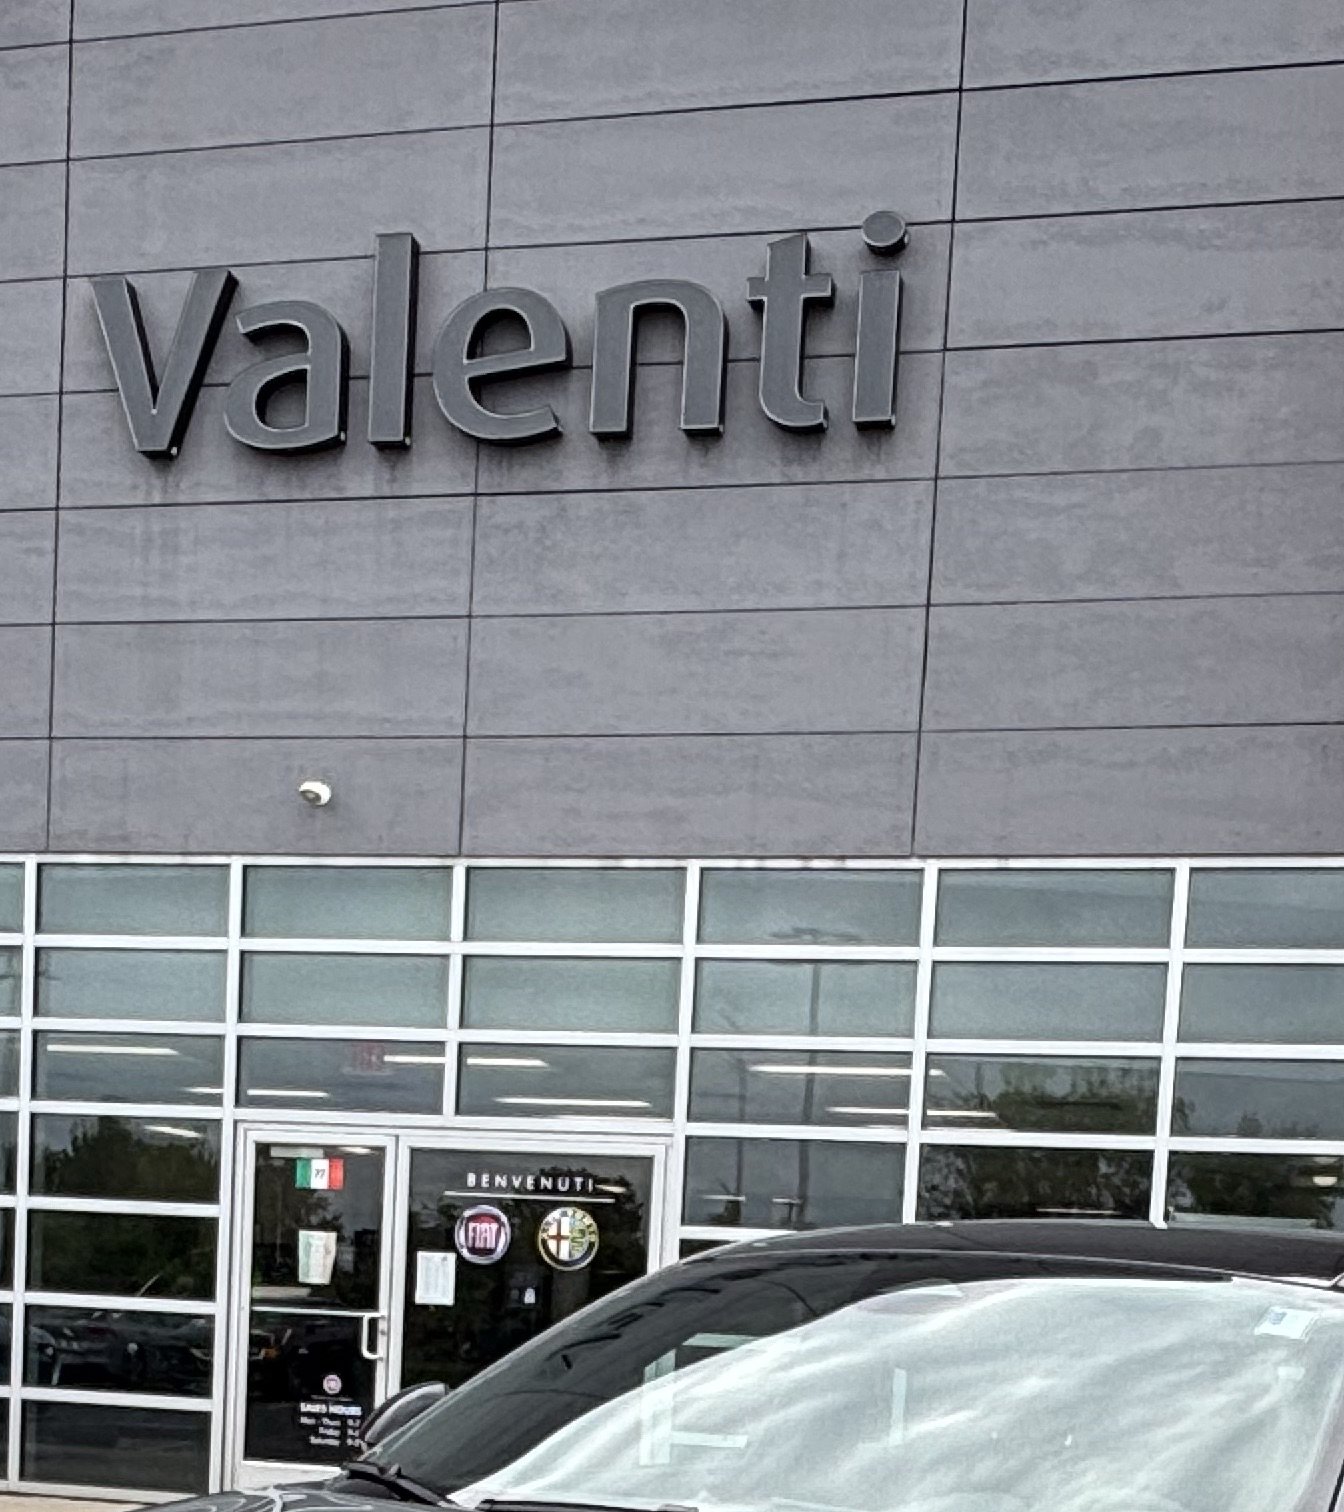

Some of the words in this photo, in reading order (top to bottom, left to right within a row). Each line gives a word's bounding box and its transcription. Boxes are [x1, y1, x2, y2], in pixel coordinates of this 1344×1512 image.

[88, 210, 910, 459] Valenti
[466, 1172, 594, 1193] BENVENUTI
[467, 1222, 500, 1250] FIAT
